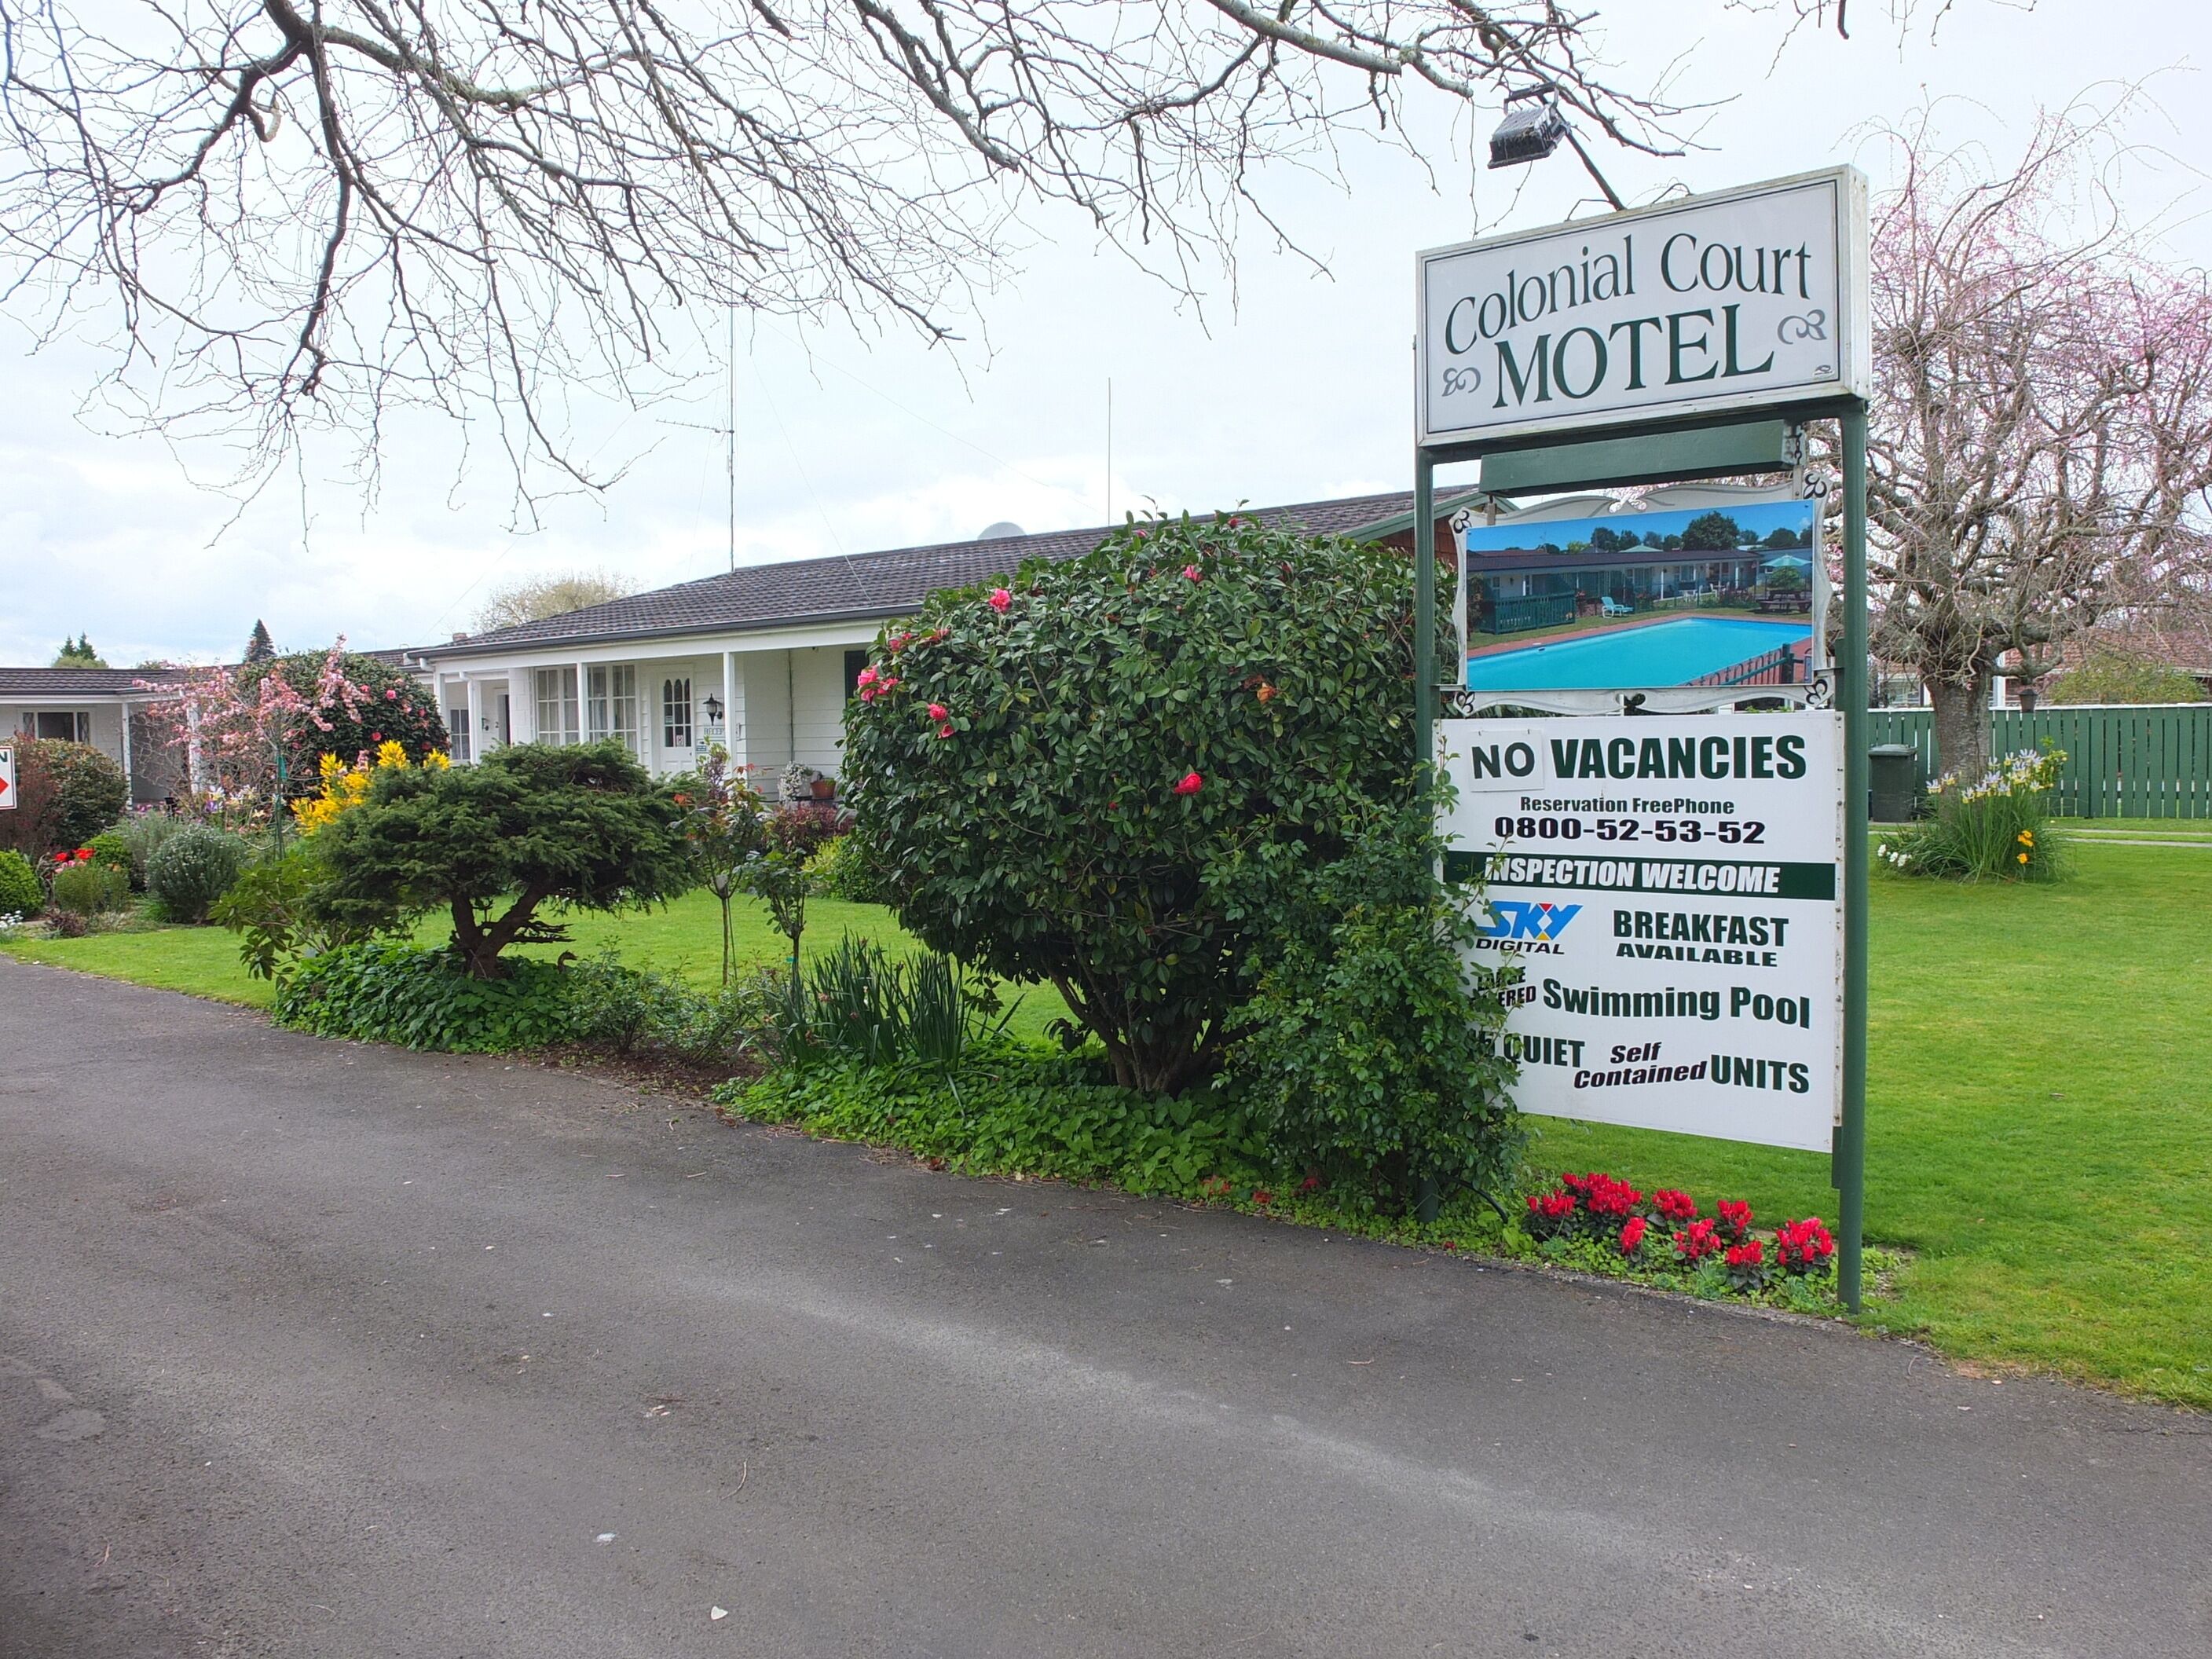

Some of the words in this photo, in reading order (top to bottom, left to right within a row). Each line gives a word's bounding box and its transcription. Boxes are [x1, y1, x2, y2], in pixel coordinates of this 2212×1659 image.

[1445, 234, 1635, 355] Colonial
[1660, 233, 1812, 300] Court
[1492, 303, 1775, 409] MOTEL
[1470, 741, 1536, 779] NO
[1550, 734, 1807, 779] VACANCIES
[1520, 796, 1628, 814] Reservation
[1632, 797, 1735, 815] FreePhone
[1494, 816, 1766, 844] 0800-52-53-52
[1484, 856, 1636, 888] INSPECTION
[1641, 862, 1781, 893] WELCOME
[1475, 900, 1584, 941] SKY
[1613, 910, 1789, 947] BREAKFAST
[1475, 938, 1566, 955] DIGITAL
[1615, 943, 1778, 967] AVAILABLE
[1542, 978, 1721, 1020] Swimming
[1730, 987, 1810, 1029] Pool
[1503, 1032, 1585, 1068] QUIET
[1610, 1042, 1662, 1064] Self
[1573, 1060, 1708, 1089] Contained
[1710, 1053, 1810, 1094] UNITS
